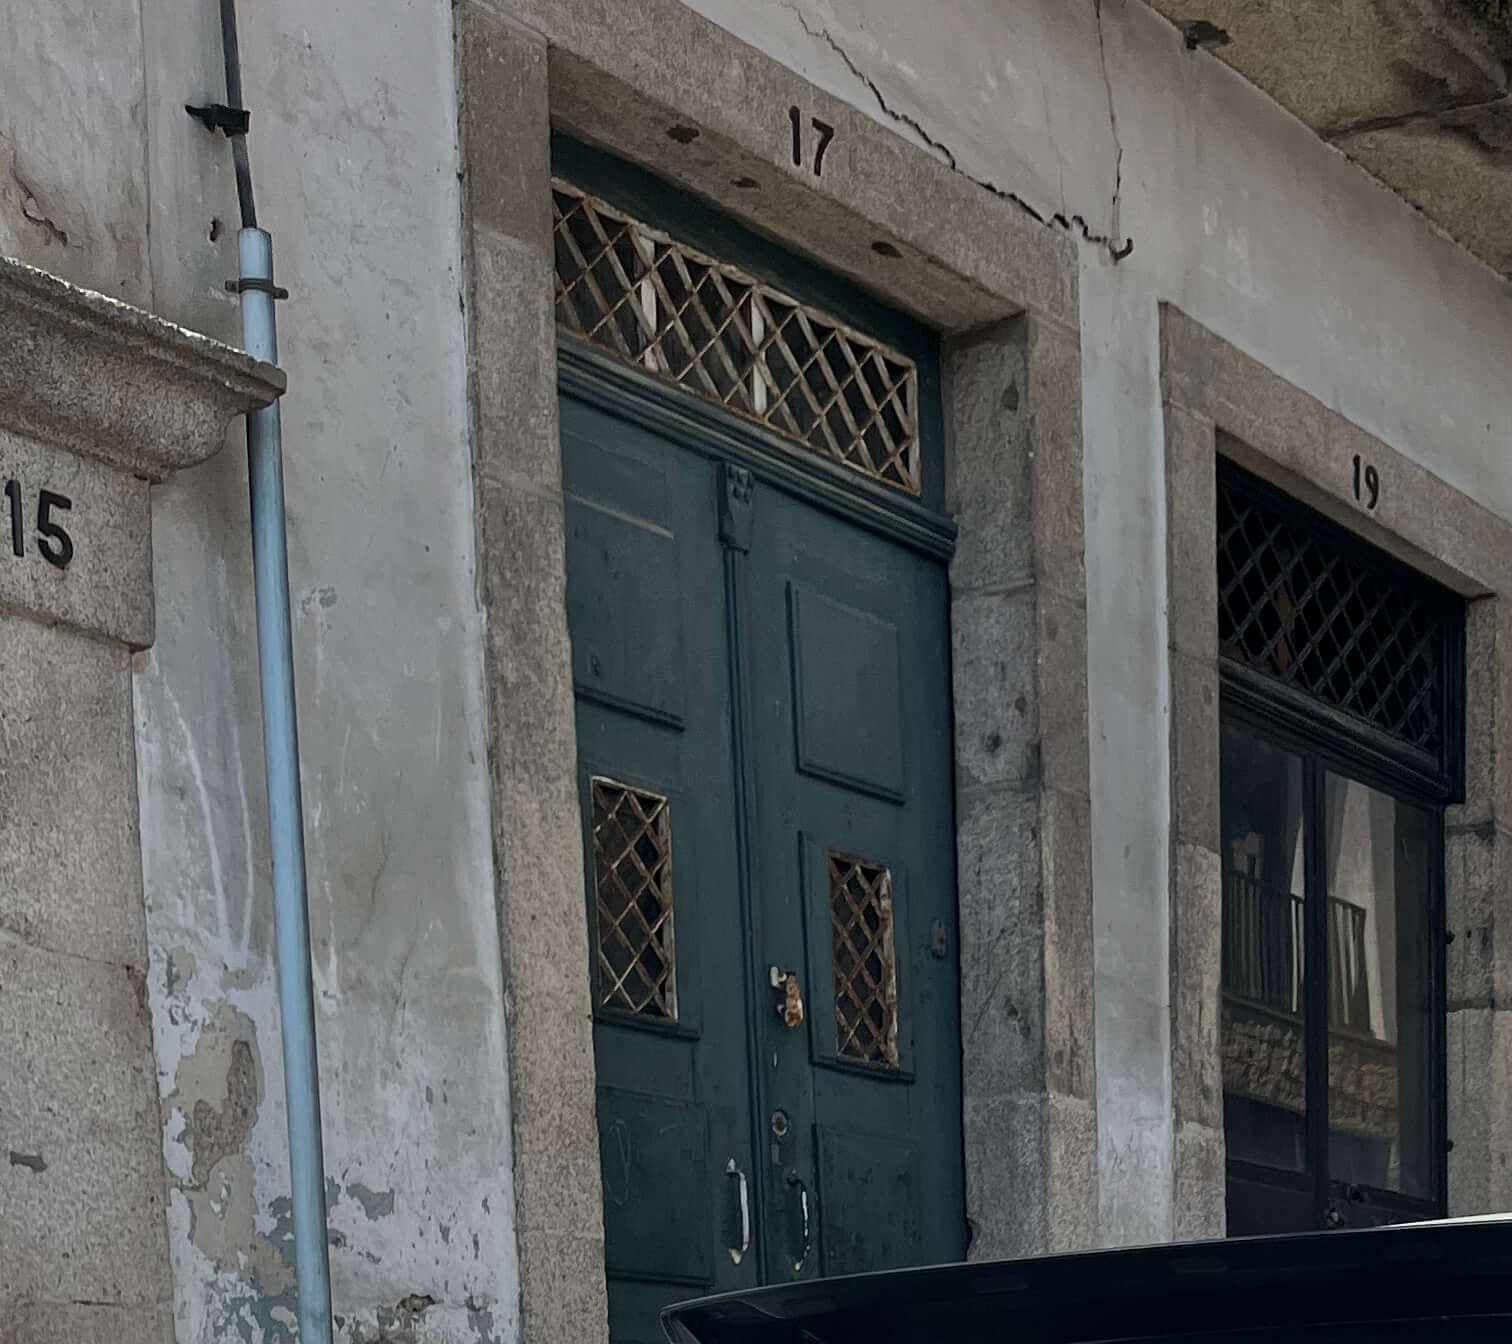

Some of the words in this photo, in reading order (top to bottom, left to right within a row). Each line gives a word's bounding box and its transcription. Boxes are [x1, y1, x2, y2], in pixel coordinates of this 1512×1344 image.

[789, 105, 834, 176] 17
[1353, 454, 1379, 510] 19
[4, 479, 74, 570] 15
